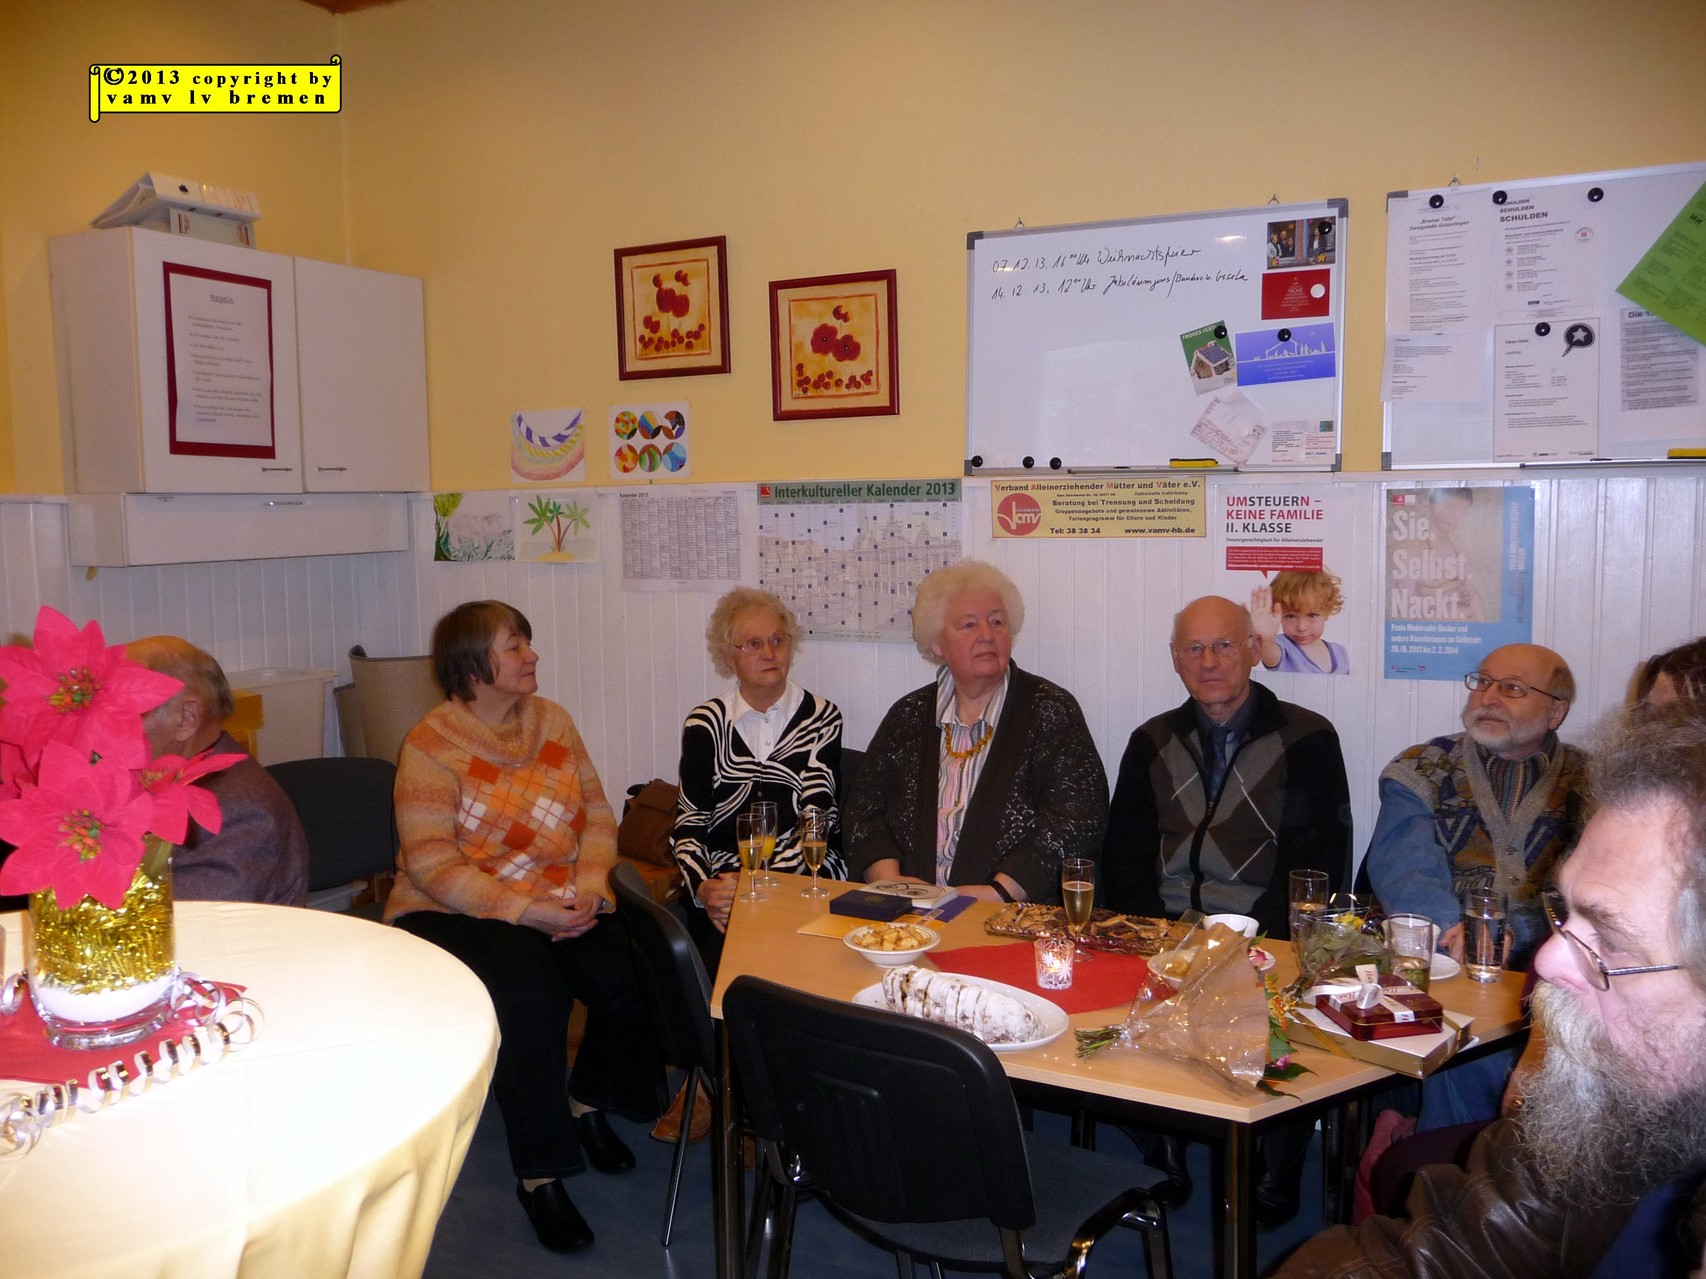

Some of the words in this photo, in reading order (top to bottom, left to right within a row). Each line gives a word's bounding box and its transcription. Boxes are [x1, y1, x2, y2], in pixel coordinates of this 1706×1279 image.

[1500, 205, 1534, 213] SCHULDEN
[1499, 211, 1548, 222] SCHULDEN
[774, 484, 863, 499] Interkultureller
[866, 483, 921, 496] Kalender
[925, 482, 956, 495] 2013
[995, 483, 1029, 491] Verband
[1031, 482, 1104, 491] Alleinerziehender
[1106, 481, 1135, 490] Mütter
[1137, 481, 1154, 489] und
[1156, 480, 1181, 489] Väter
[1183, 480, 1201, 488] e.V.
[1154, 498, 1195, 506] Scheidung
[1226, 495, 1310, 507] UMSTEUERN
[1226, 509, 1265, 520] KEINE
[1269, 509, 1323, 520] FAMILIE
[1225, 522, 1239, 533] II.
[1242, 522, 1292, 533] KLASSE
[1392, 510, 1436, 541] Sie.
[1391, 549, 1473, 580] Selbst.
[1391, 587, 1466, 619] Nackt.
[1391, 623, 1406, 632] Paula
[1458, 624, 1469, 632] und
